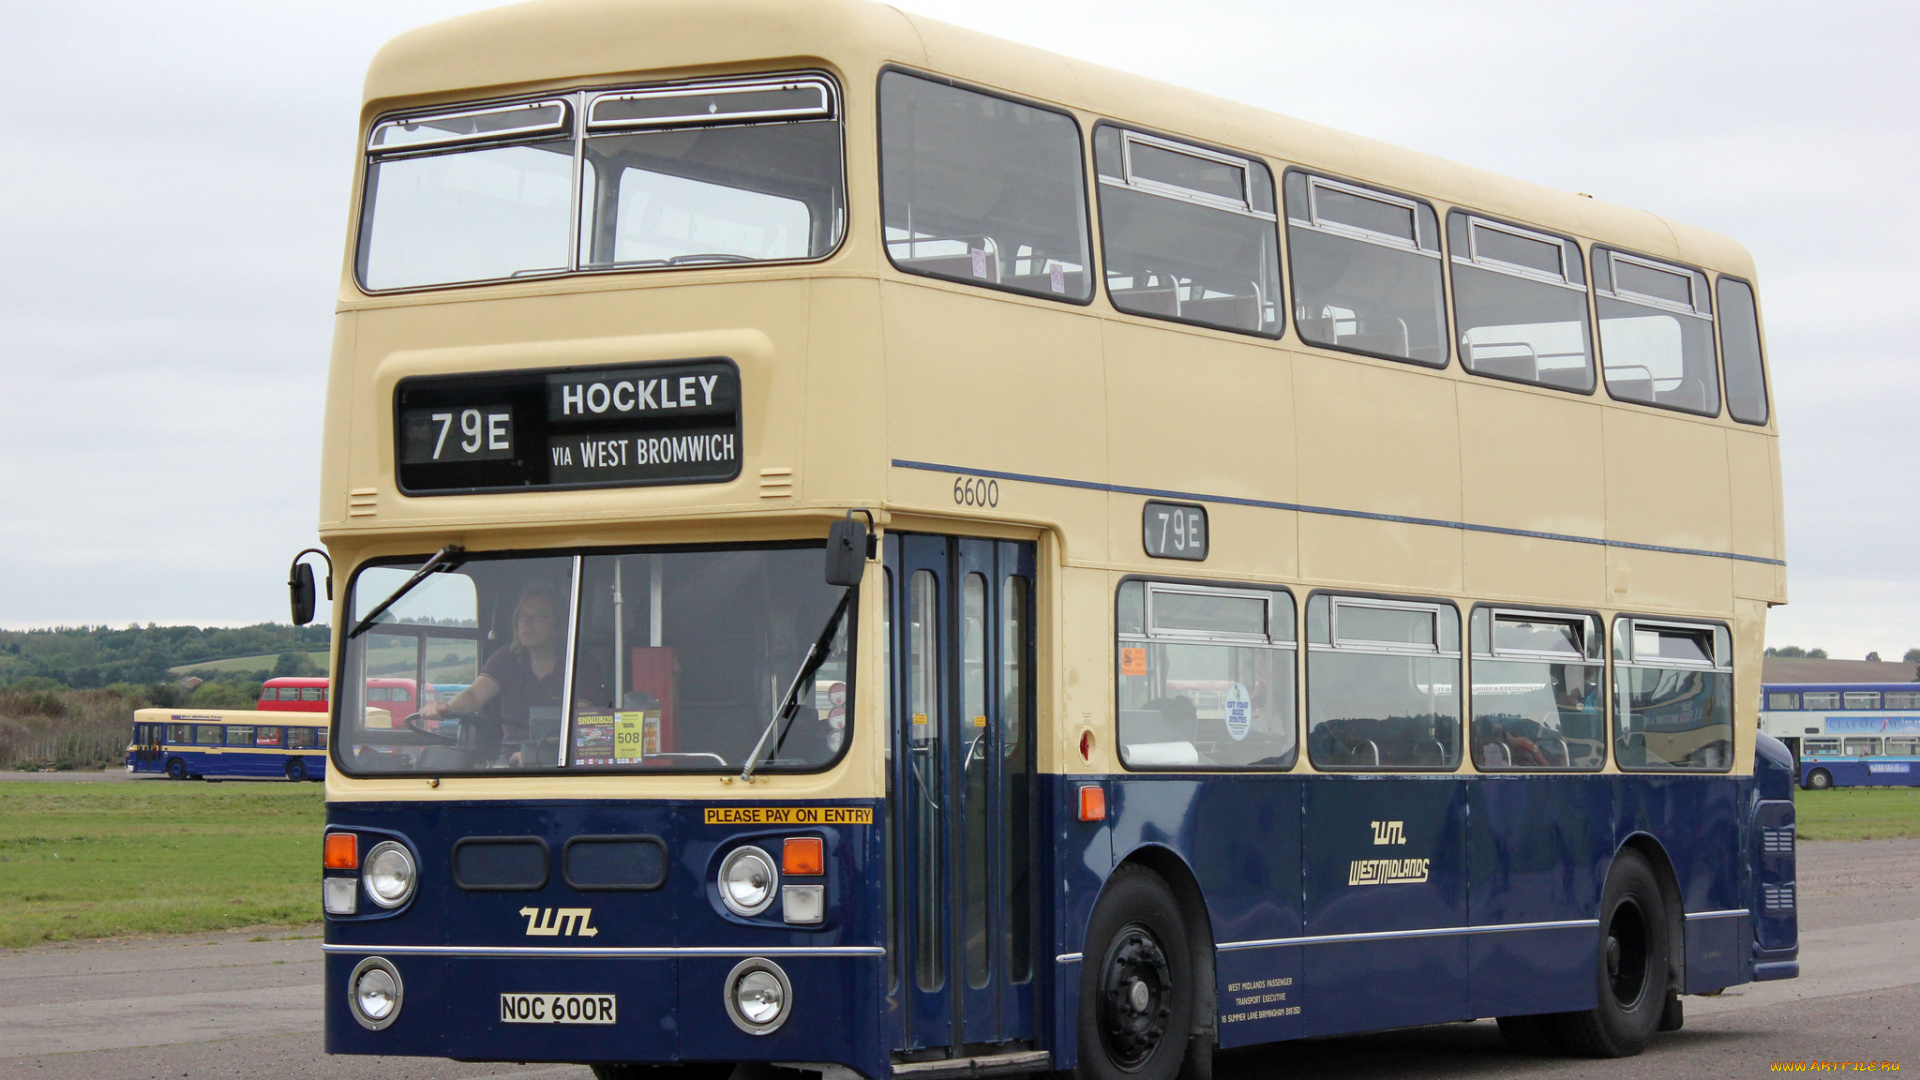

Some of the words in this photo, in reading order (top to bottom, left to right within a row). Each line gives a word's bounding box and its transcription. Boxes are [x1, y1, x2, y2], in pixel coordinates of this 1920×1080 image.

[562, 375, 718, 416] HOCKLEY
[431, 408, 510, 460] 79E
[552, 446, 573, 466] VIA
[580, 440, 629, 468] WEST
[637, 433, 735, 465] BROMWICH
[953, 476, 999, 508] 6600
[1158, 509, 1200, 553] 79E
[577, 715, 614, 725] SHOWBUS
[1829, 719, 1877, 729] CLASSIC
[617, 732, 640, 744] 508
[707, 809, 761, 822] PLEASE
[765, 809, 791, 822] PAY
[795, 809, 817, 822] ON
[824, 809, 872, 822] ENTRY
[1227, 982, 1241, 992] WEST
[1241, 980, 1266, 991] MIDLANDS
[1266, 977, 1293, 988] PASSENGER
[1235, 995, 1261, 1006] TRANSPORT
[1262, 992, 1286, 1003] EXECUTIVE
[502, 996, 545, 1020] NOC
[551, 996, 613, 1021] 600R
[1221, 1015, 1227, 1024] 16
[1228, 1012, 1246, 1023] SUMMER
[1247, 1010, 1259, 1020] LANE
[1259, 1008, 1285, 1019] BIRMINGHAM
